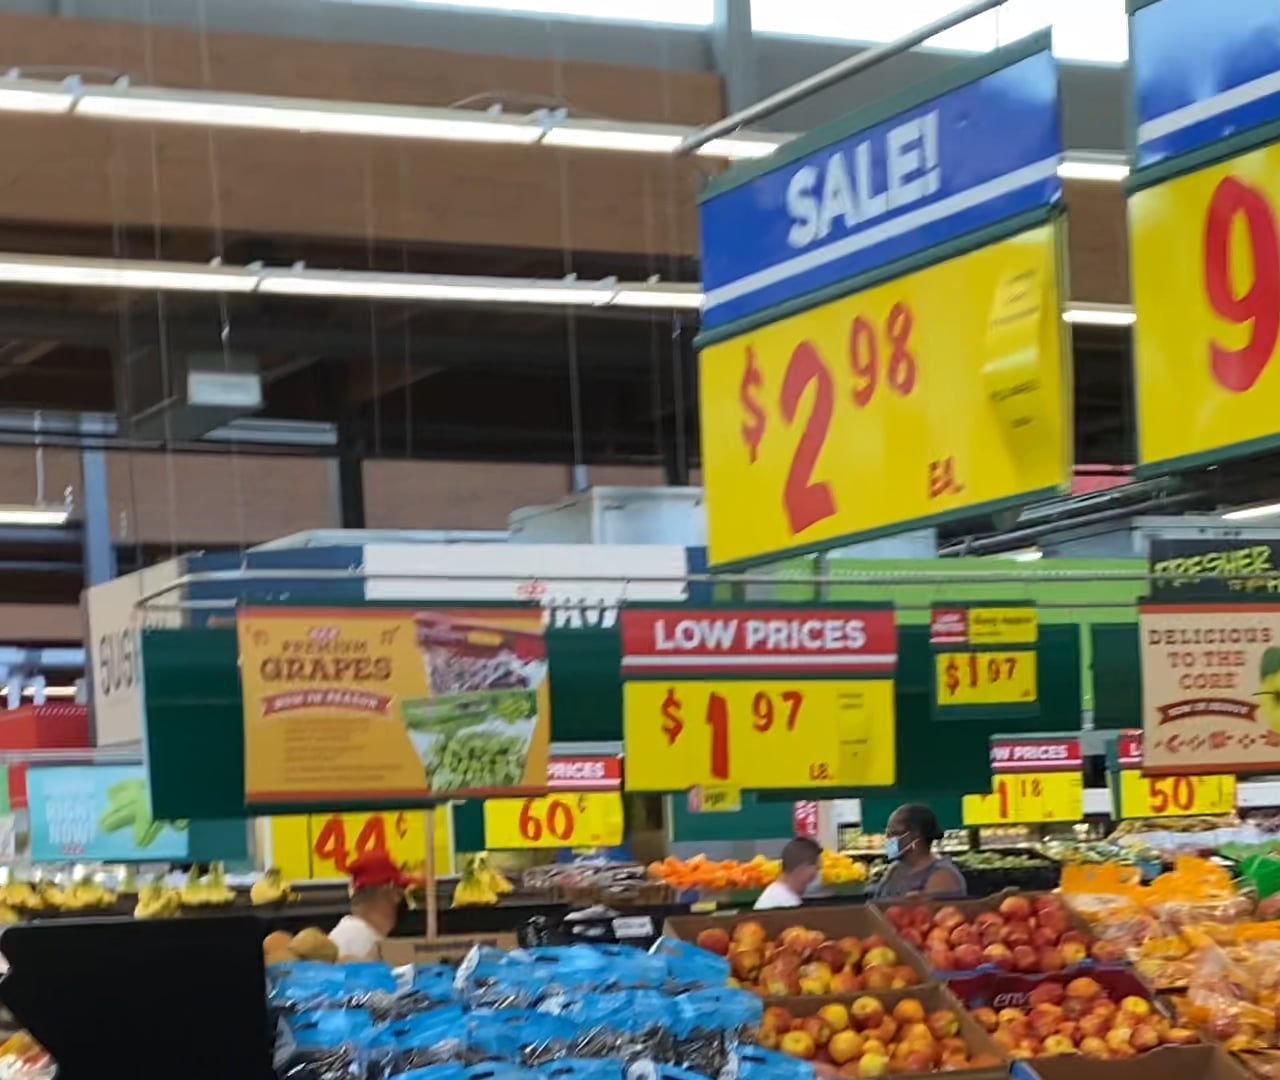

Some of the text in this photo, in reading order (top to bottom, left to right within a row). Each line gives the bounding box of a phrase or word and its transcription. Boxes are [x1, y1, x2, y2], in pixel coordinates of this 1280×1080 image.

[784, 111, 942, 248] SALE!
[655, 618, 866, 650] LOW PRICES
[1148, 627, 1272, 646] DELICIOUS
[260, 657, 393, 682] GRAPES
[1168, 650, 1246, 668] TO THE
[1179, 673, 1238, 690] CORE
